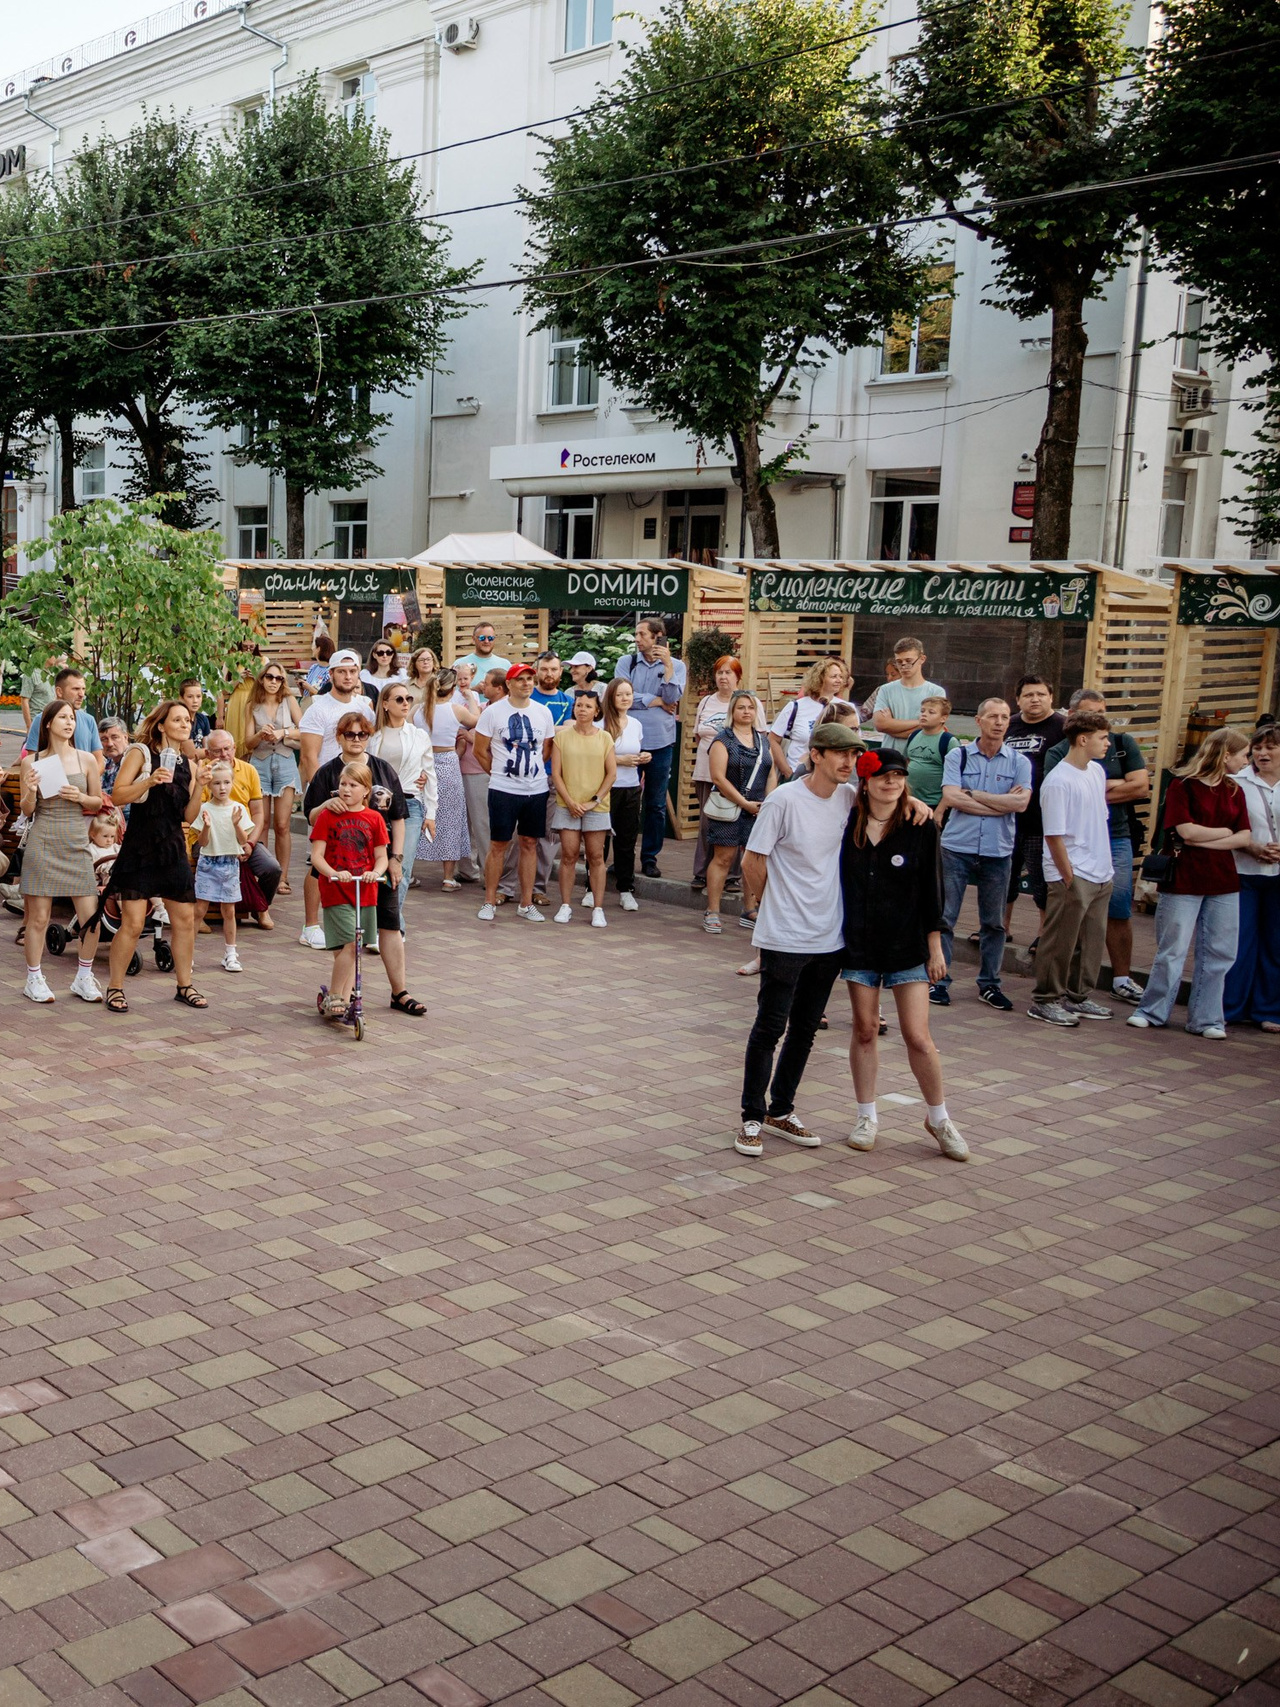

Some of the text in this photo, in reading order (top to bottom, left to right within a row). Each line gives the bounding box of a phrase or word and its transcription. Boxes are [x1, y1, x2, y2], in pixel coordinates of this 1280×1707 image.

[573, 452, 656, 467] Ростелеком
[465, 573, 534, 588] Смоленские
[760, 572, 1027, 602] Смоленские Сласти
[479, 588, 523, 602] сезоны
[594, 597, 651, 608] рестораны
[870, 600, 933, 616] десерты
[938, 604, 949, 615] и
